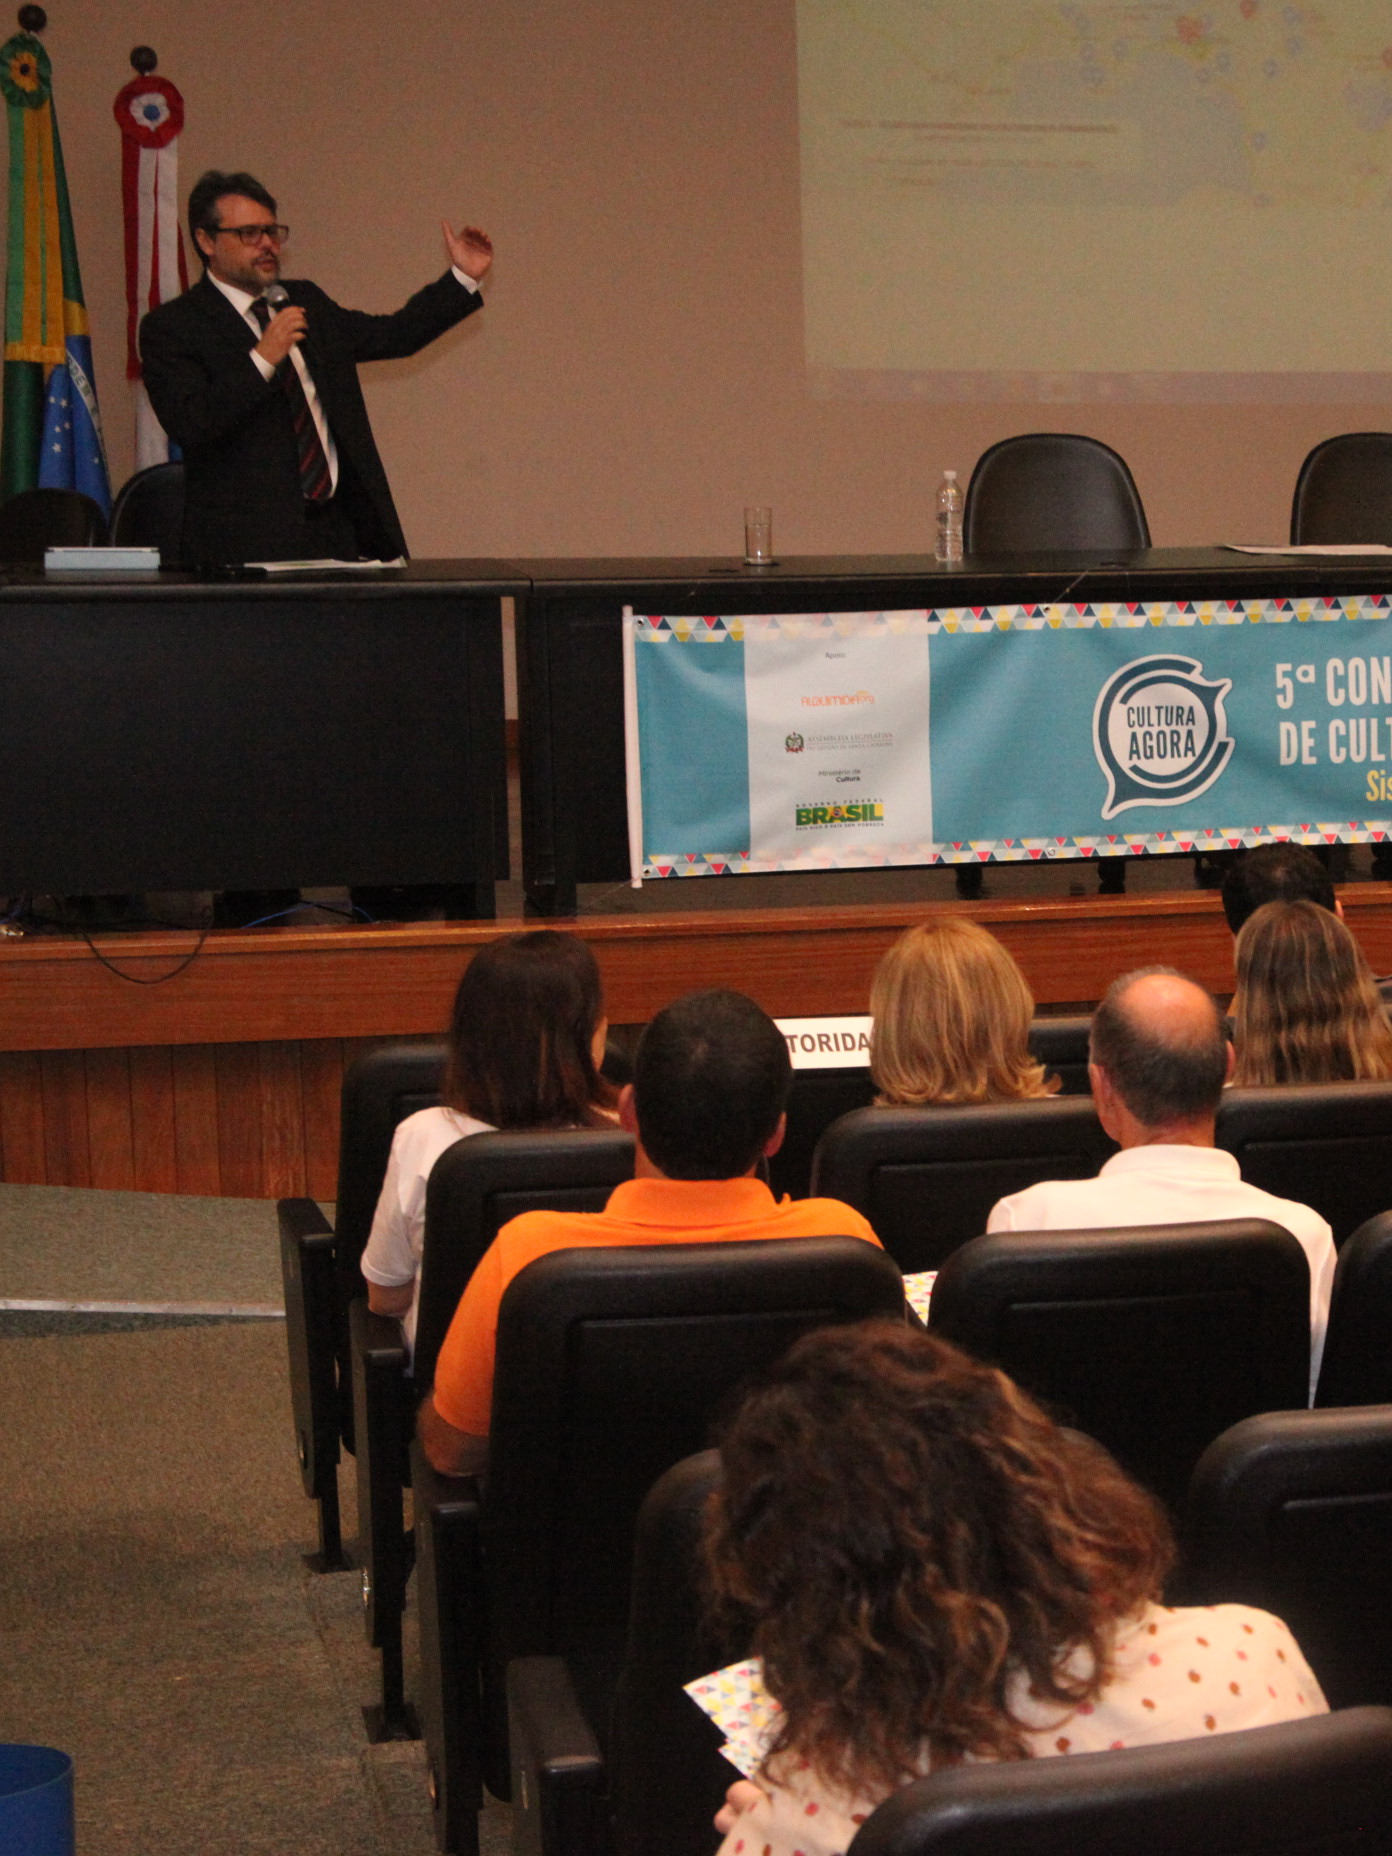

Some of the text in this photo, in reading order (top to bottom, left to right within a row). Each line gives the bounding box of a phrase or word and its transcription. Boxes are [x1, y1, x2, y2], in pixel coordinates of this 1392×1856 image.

[1276, 663, 1316, 709] 5ª
[1127, 705, 1196, 728] CULTURA
[1128, 729, 1197, 761] AGORA
[1279, 720, 1317, 765] DE
[796, 803, 884, 826] BRASIL
[785, 1033, 872, 1053] TORIDA
